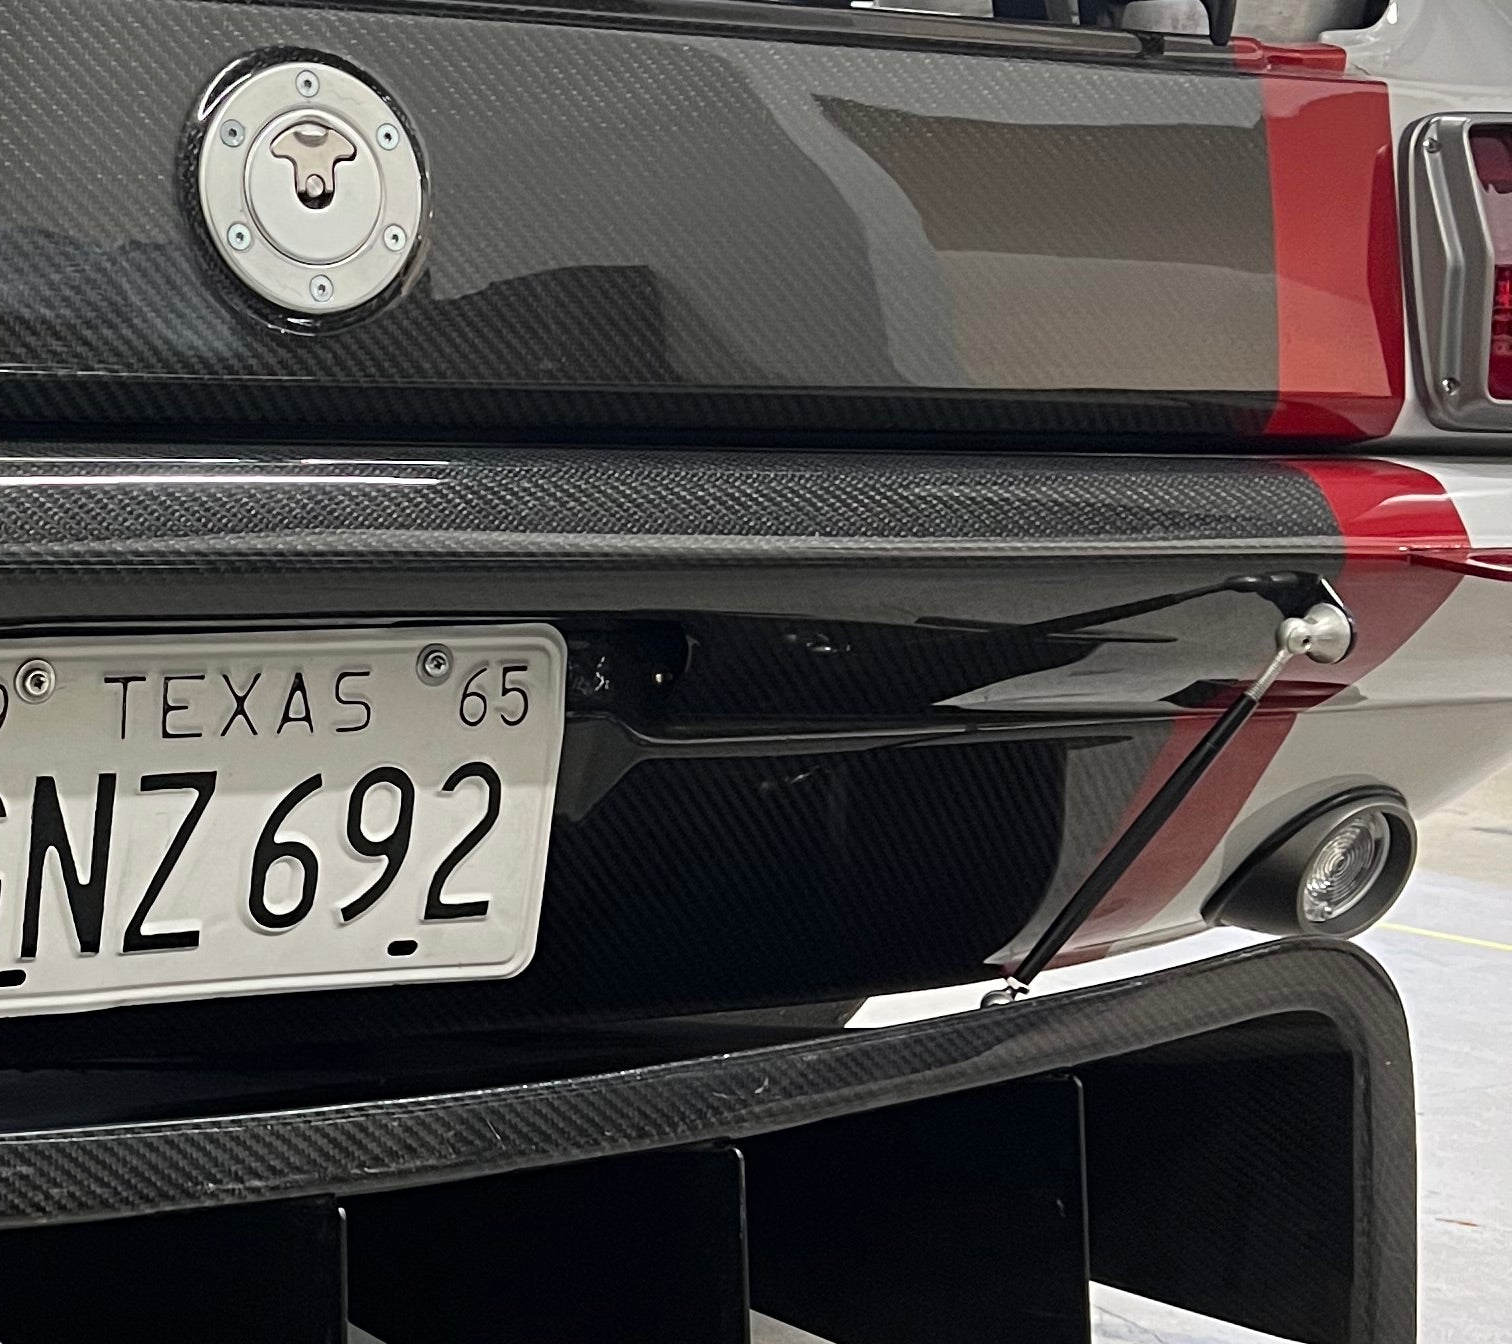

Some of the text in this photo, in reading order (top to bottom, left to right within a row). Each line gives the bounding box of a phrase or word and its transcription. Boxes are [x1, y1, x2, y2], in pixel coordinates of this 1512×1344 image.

[103, 670, 372, 741] TEXAS
[458, 663, 530, 728] 65
[247, 760, 503, 930] 692
